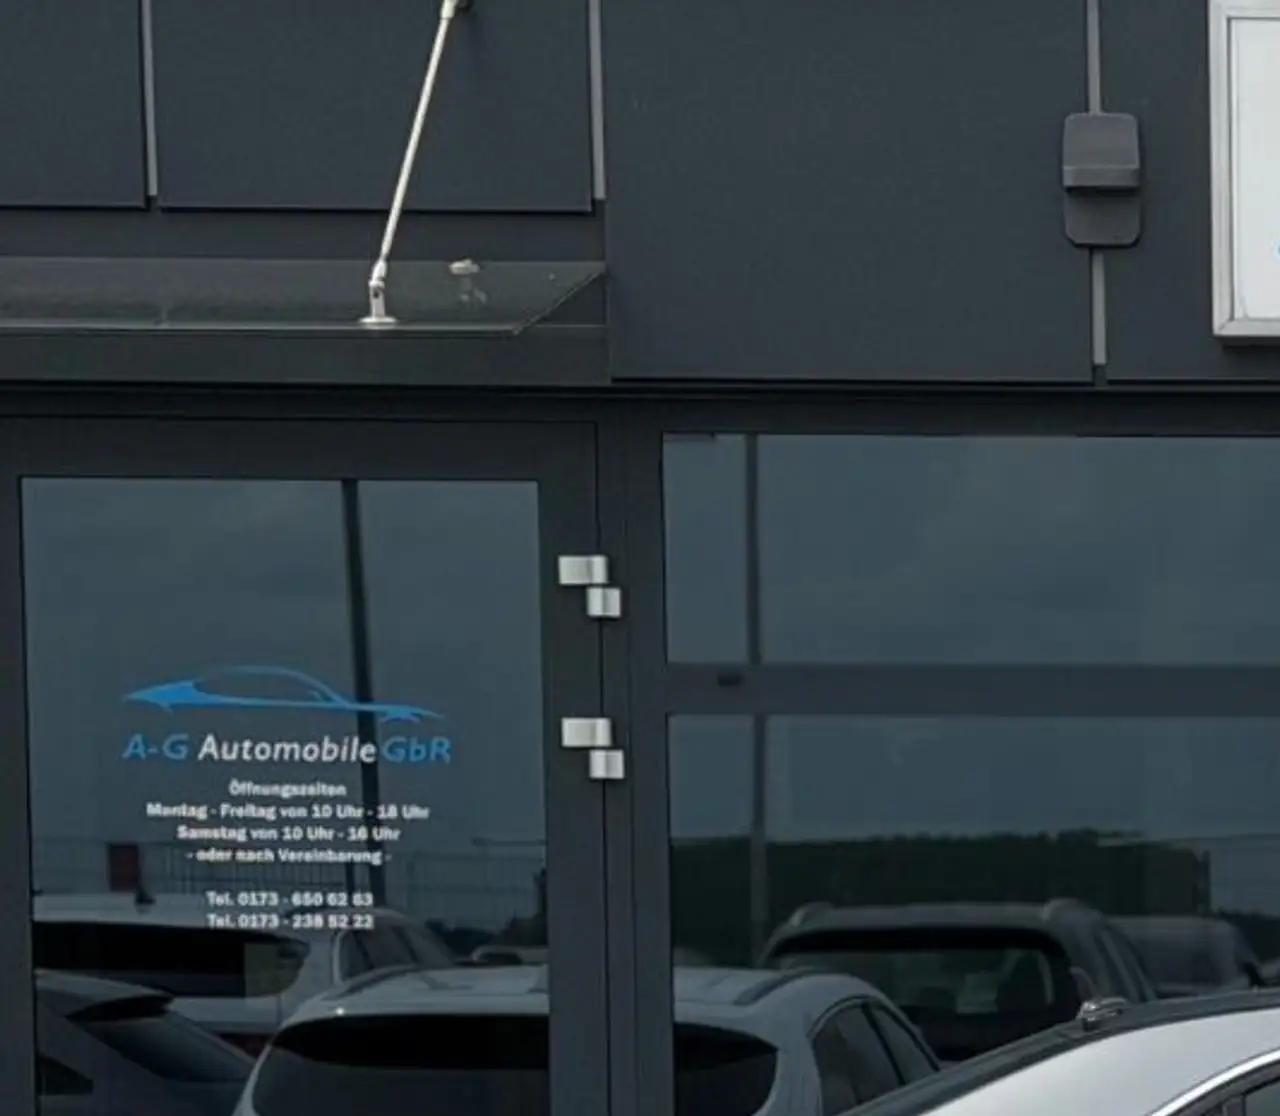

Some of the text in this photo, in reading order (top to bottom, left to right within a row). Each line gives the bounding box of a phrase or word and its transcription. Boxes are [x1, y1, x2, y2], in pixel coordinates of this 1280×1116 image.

[122, 733, 451, 764] A-G Automobile GbR
[228, 777, 347, 798] Öffnungszeiten
[146, 803, 208, 820] Montag
[220, 803, 277, 821] Freitag
[280, 806, 308, 819] von
[312, 803, 333, 819] 10
[336, 803, 364, 819] Uhr
[402, 803, 430, 819] Uhr
[177, 825, 248, 844] Samstag
[250, 828, 279, 842] von
[283, 825, 304, 841] 10
[307, 825, 336, 841] Uhr
[373, 825, 401, 841] Uhr
[195, 848, 233, 863] oder
[235, 848, 275, 863] nach
[277, 848, 383, 866] Vereinbarung
[207, 891, 235, 906] Tel.
[237, 891, 280, 907] 0173
[207, 913, 235, 928] Tel.
[237, 913, 280, 929] 0173
